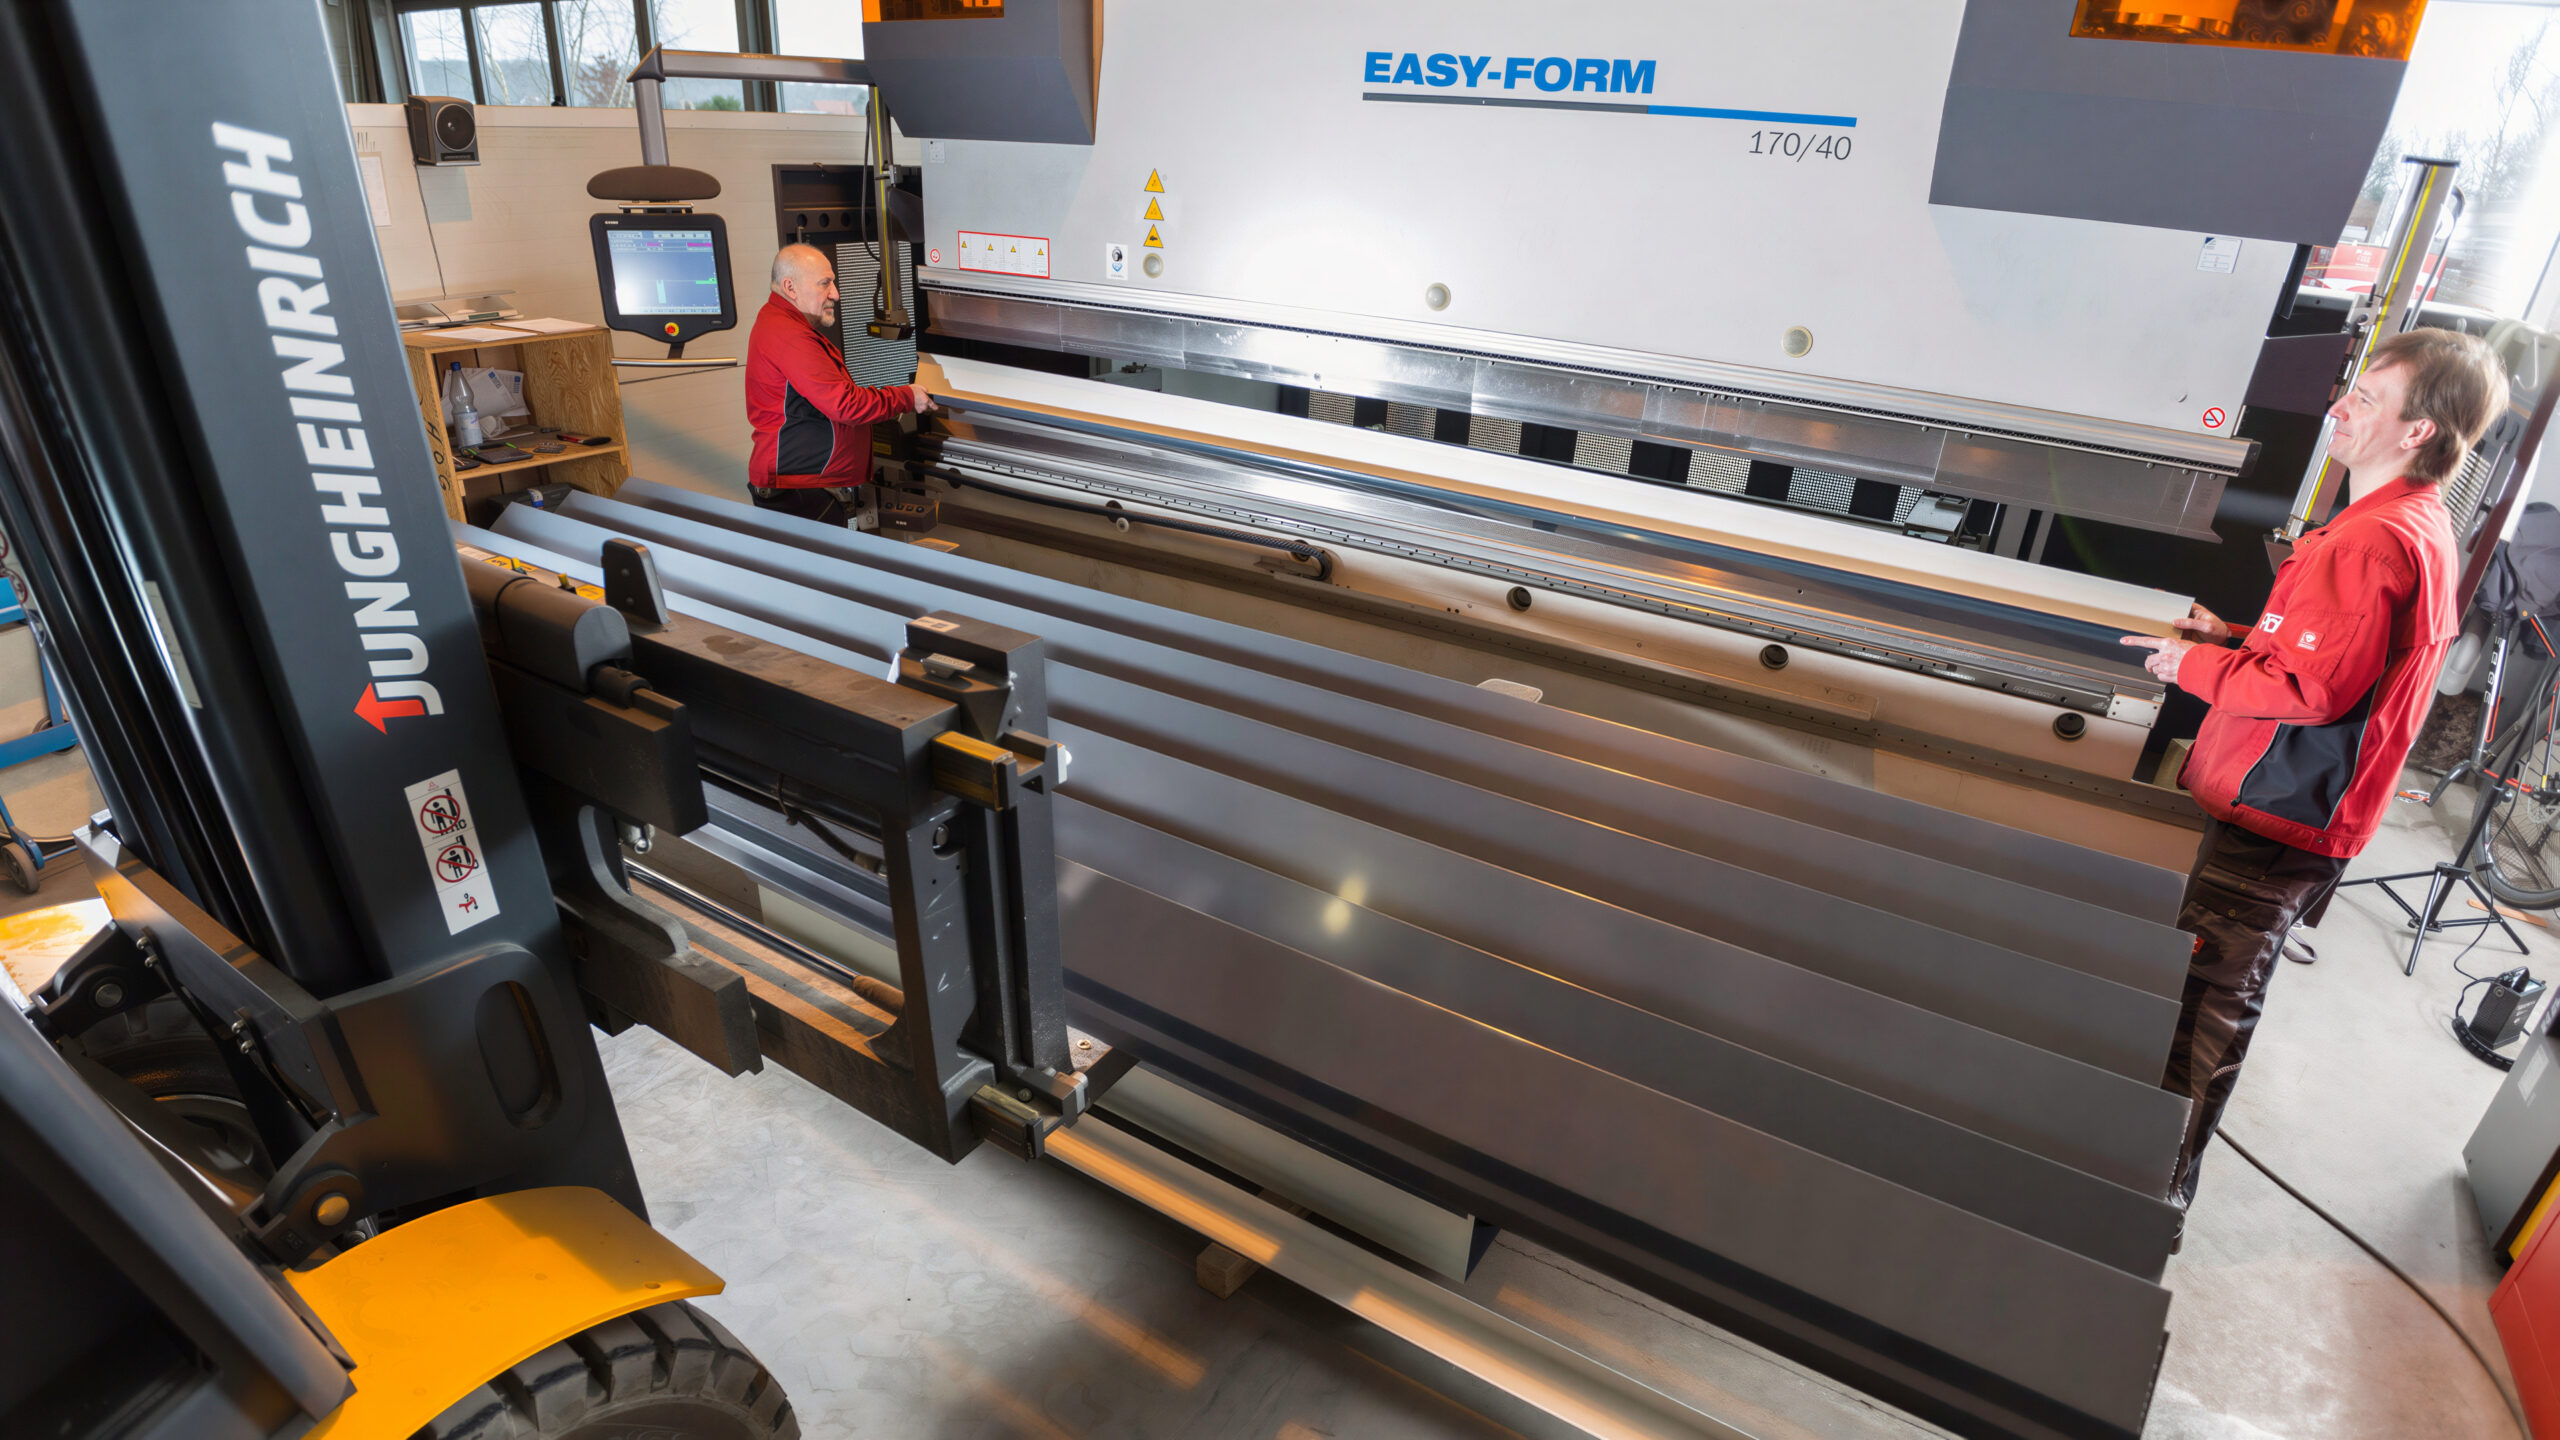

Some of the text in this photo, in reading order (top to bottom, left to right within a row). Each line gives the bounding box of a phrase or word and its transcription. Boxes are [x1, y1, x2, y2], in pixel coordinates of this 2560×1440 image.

[1364, 51, 1656, 94] EASY-FORM
[1749, 130, 1852, 163] 170/40
[212, 121, 445, 716] JUNGHEINRICH
